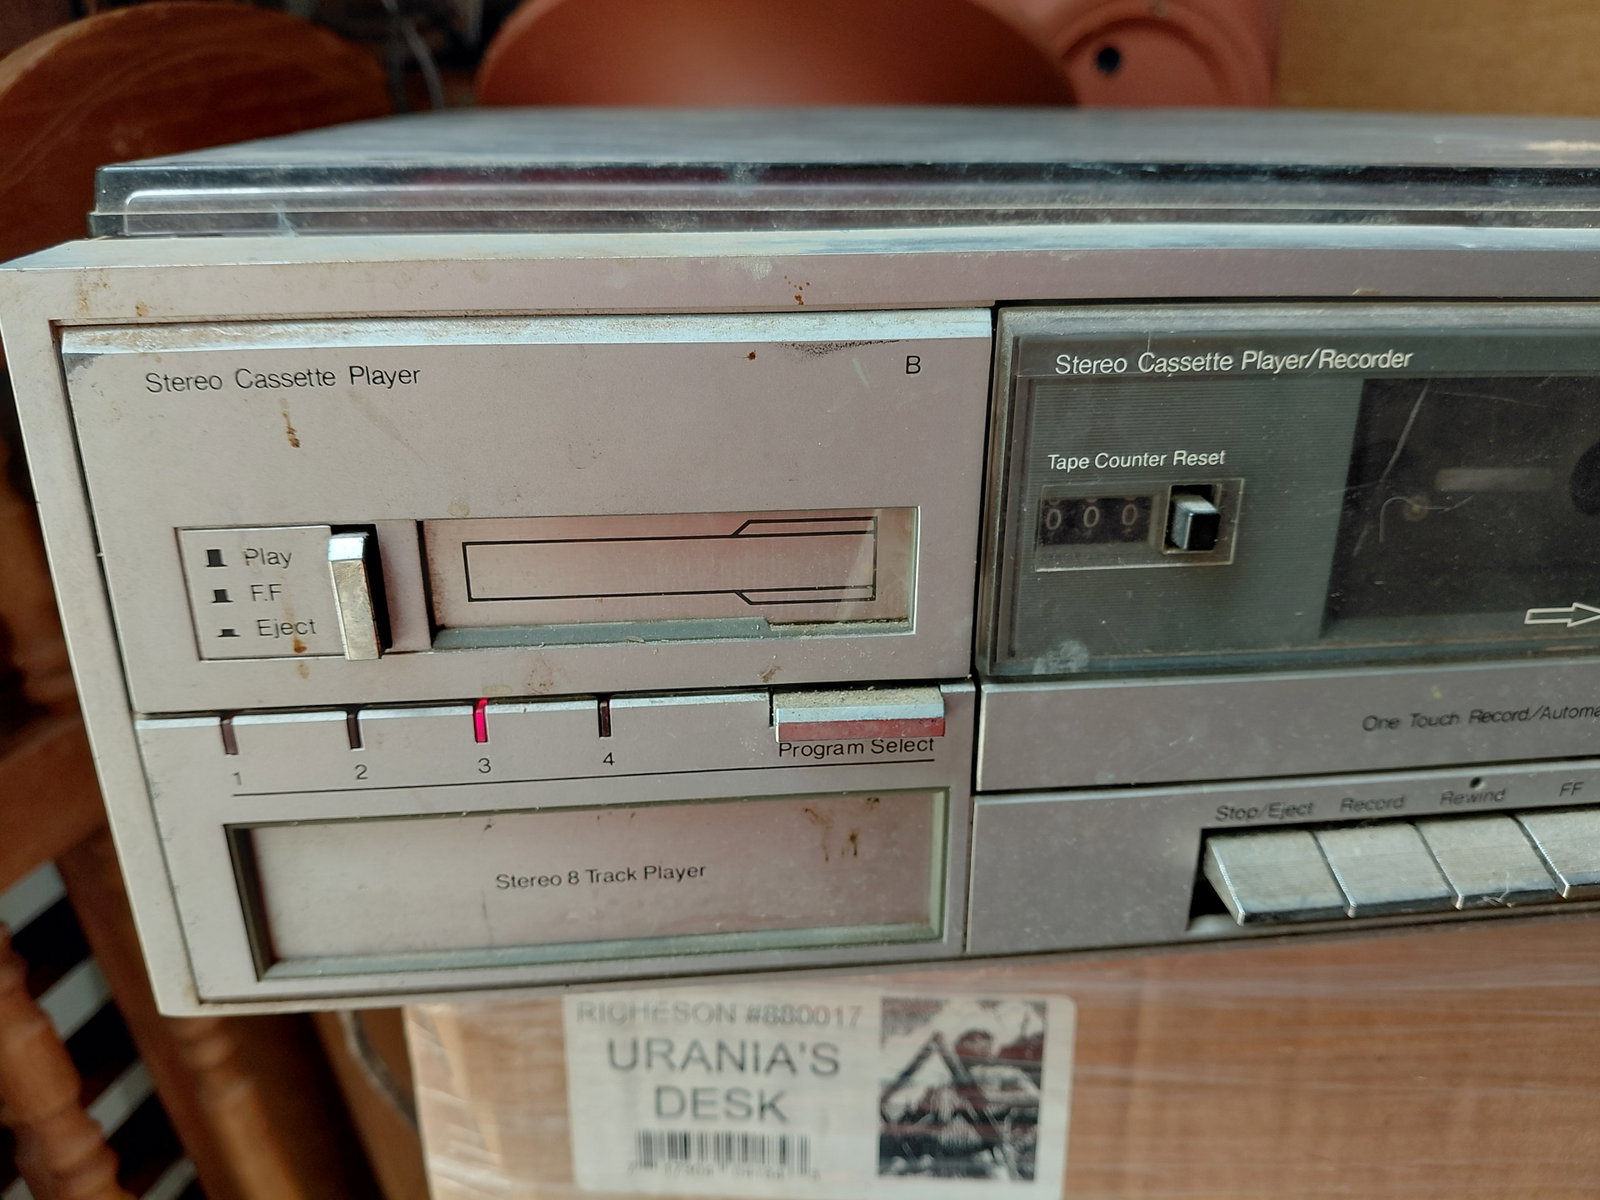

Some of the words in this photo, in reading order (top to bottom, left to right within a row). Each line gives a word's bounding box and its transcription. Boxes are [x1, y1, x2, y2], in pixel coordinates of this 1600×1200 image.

[906, 355, 921, 375] B
[1055, 354, 1128, 376] Stereo
[1138, 352, 1234, 374] Cassette
[1240, 348, 1413, 373] Player/Recorder
[145, 371, 224, 393] Stereo
[234, 366, 337, 390] Cassette
[349, 365, 421, 390] Player
[1048, 454, 1090, 472] Tape
[1094, 451, 1168, 469] Counter
[1172, 450, 1226, 466] Reset
[243, 547, 292, 569] Play
[257, 618, 317, 639] Eject
[1362, 715, 1399, 732] One
[1410, 711, 1460, 728] Touch
[778, 739, 865, 760] Program
[870, 737, 935, 754] Select
[478, 757, 493, 774] 3
[602, 752, 616, 767] 4
[232, 771, 242, 786] 1
[354, 764, 369, 781] 2
[1440, 788, 1506, 806] Rewind
[1559, 781, 1584, 798] FF
[1215, 801, 1314, 824] Stop/Eject
[1339, 796, 1406, 814] Record
[495, 872, 562, 890] Stereo
[568, 871, 580, 885] 8
[585, 868, 637, 883] Track
[643, 864, 706, 884] Player
[608, 1037, 842, 1076] URANIA'S
[654, 1085, 790, 1124] DESK
